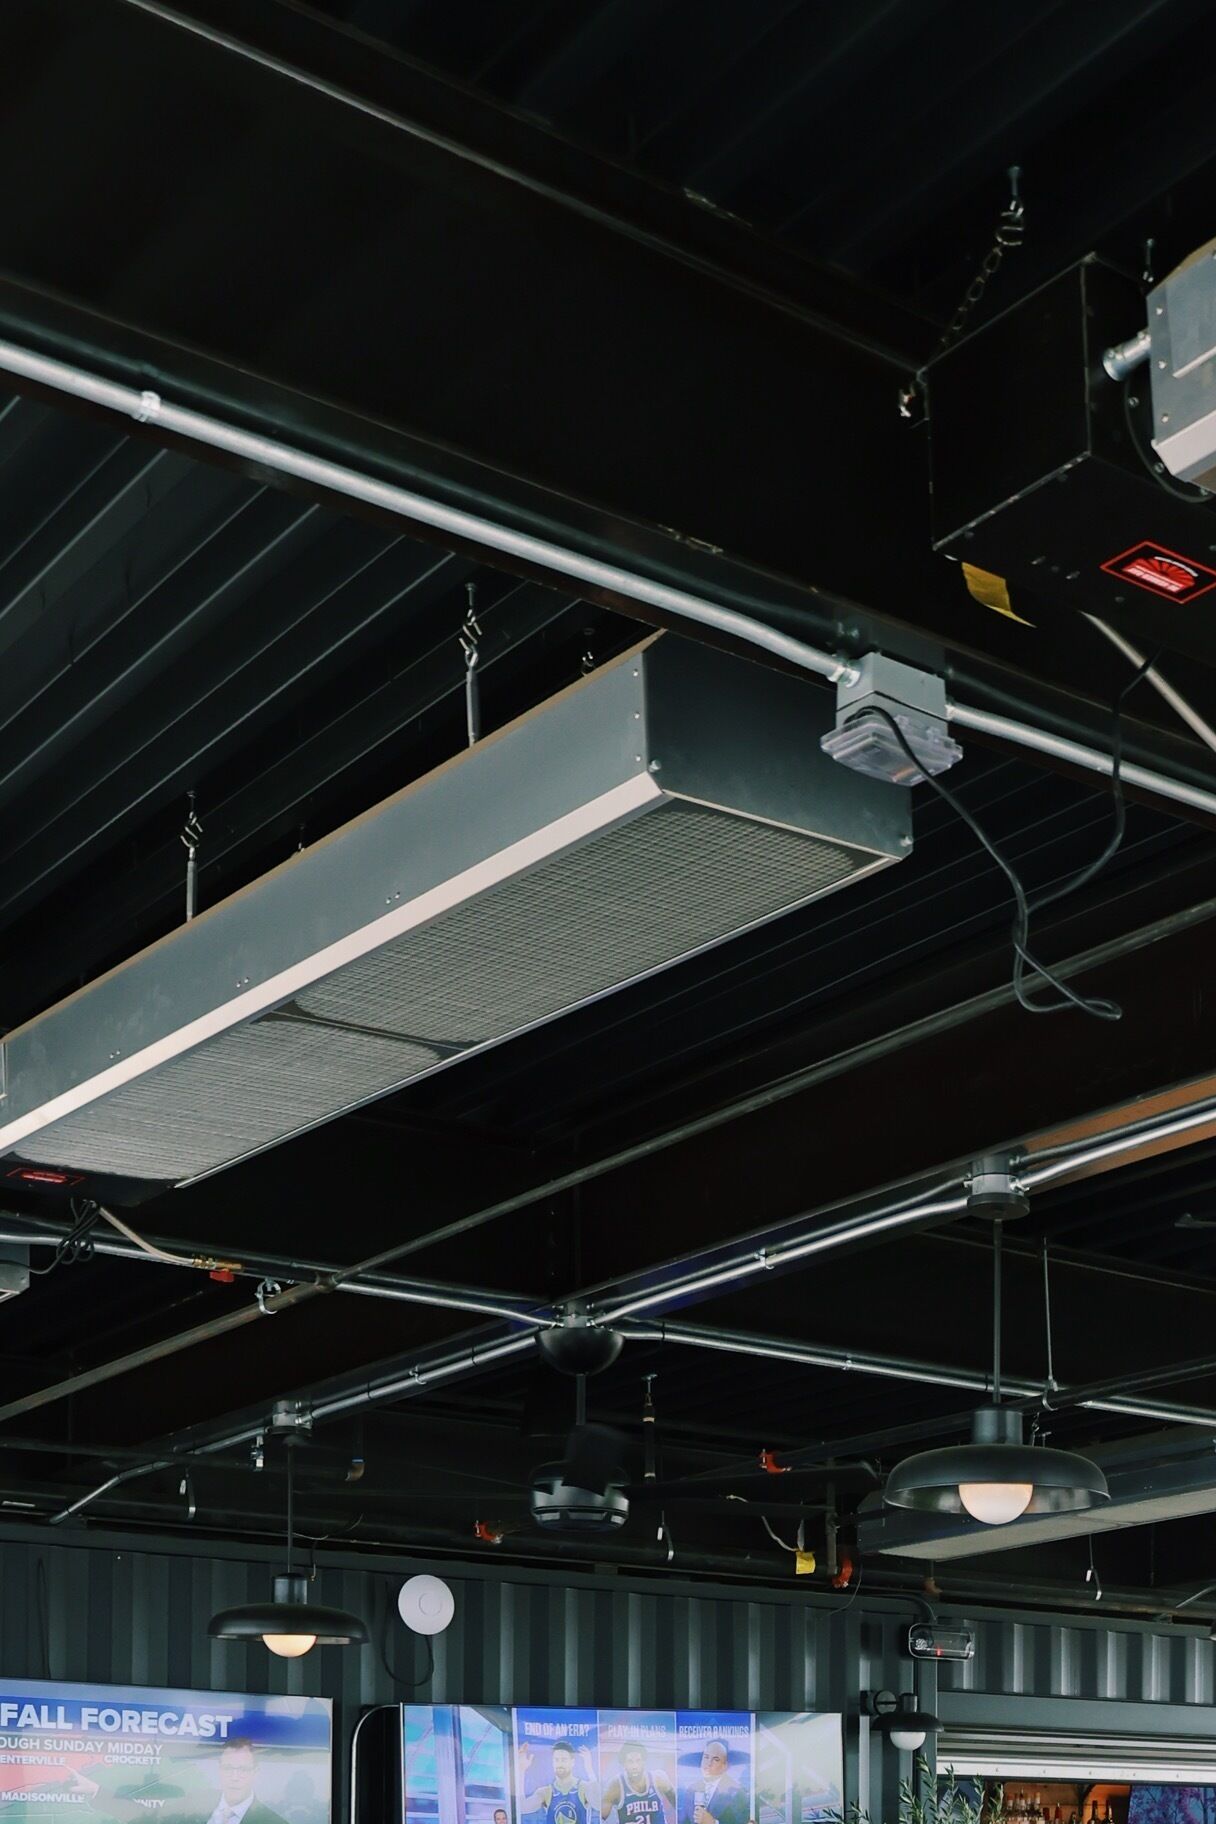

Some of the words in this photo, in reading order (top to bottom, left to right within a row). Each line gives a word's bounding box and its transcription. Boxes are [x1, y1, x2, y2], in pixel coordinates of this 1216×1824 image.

[0, 1703, 73, 1730] FALL
[81, 1707, 233, 1738] FORECAST
[524, 1722, 541, 1736] END
[543, 1723, 554, 1736] OF
[555, 1723, 568, 1736] AN
[569, 1724, 590, 1736] ERA?
[679, 1725, 712, 1738] RECEIVER
[713, 1725, 749, 1738] RANKINGS
[0, 1736, 40, 1750] OUGH
[44, 1739, 104, 1753] SUNDAY
[108, 1742, 163, 1755] MIDDAY
[104, 1755, 161, 1765] CROCKETT
[1, 1791, 85, 1803] MADISONVILLE
[626, 1800, 659, 1816] PHILA
